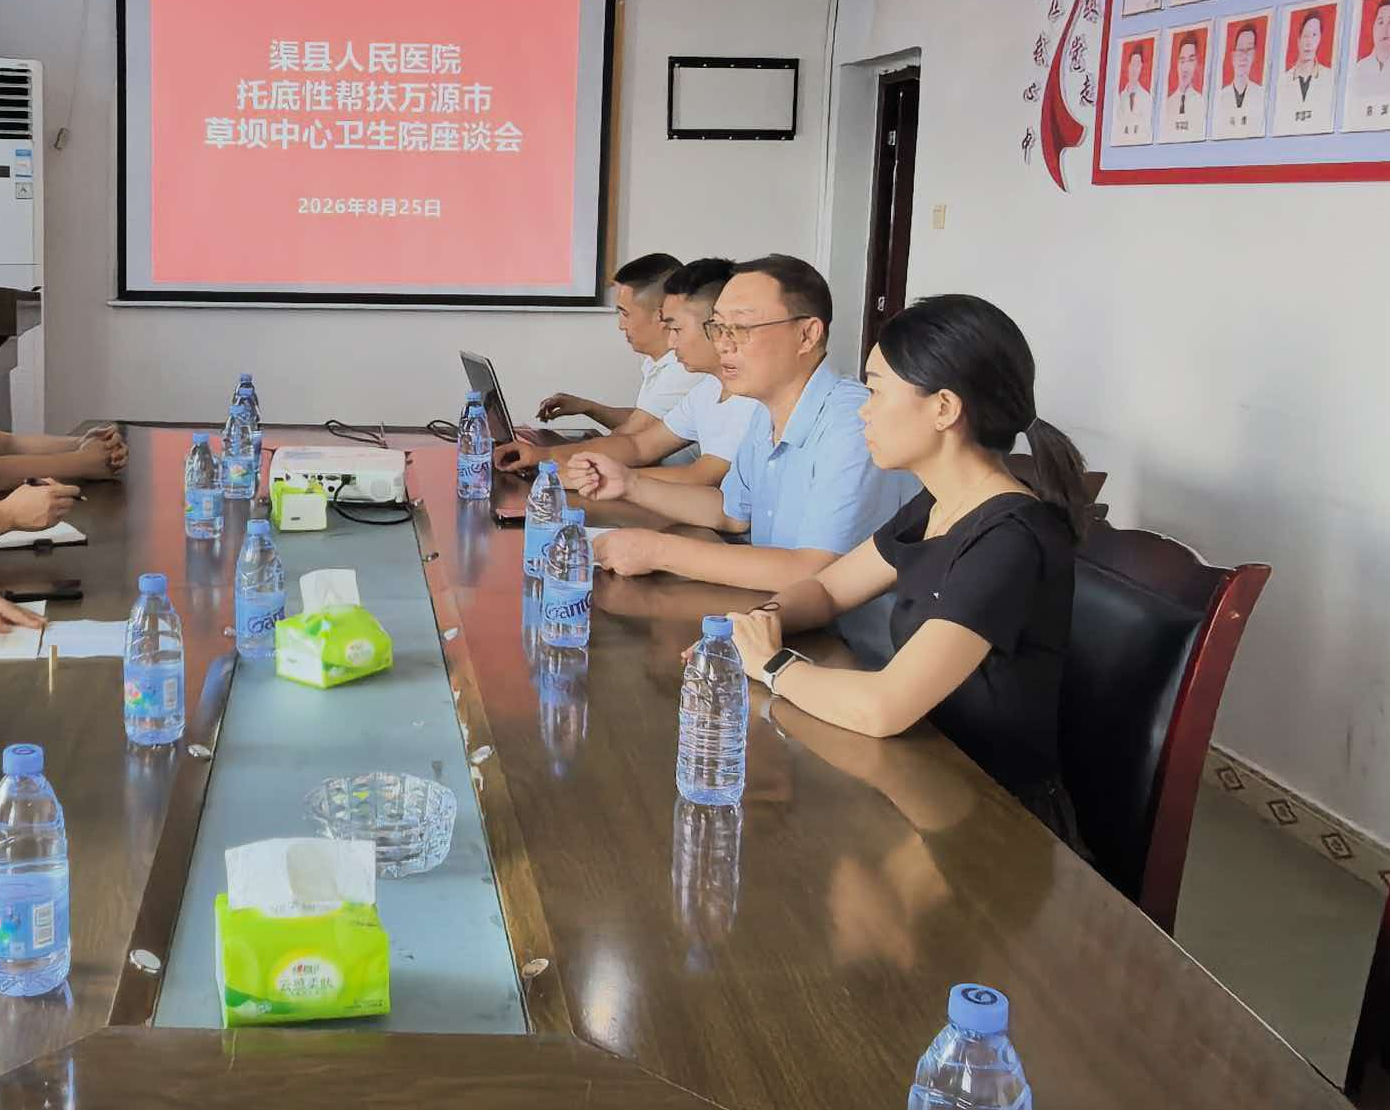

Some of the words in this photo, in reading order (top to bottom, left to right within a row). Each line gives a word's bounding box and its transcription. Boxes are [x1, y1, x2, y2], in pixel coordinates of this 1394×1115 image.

[269, 40, 462, 75] 渠县人民医院
[236, 79, 492, 114] 托底性帮扶万源市
[204, 117, 523, 153] 草坝中心卫生院座谈会
[298, 197, 442, 218] 2026年8月25日
